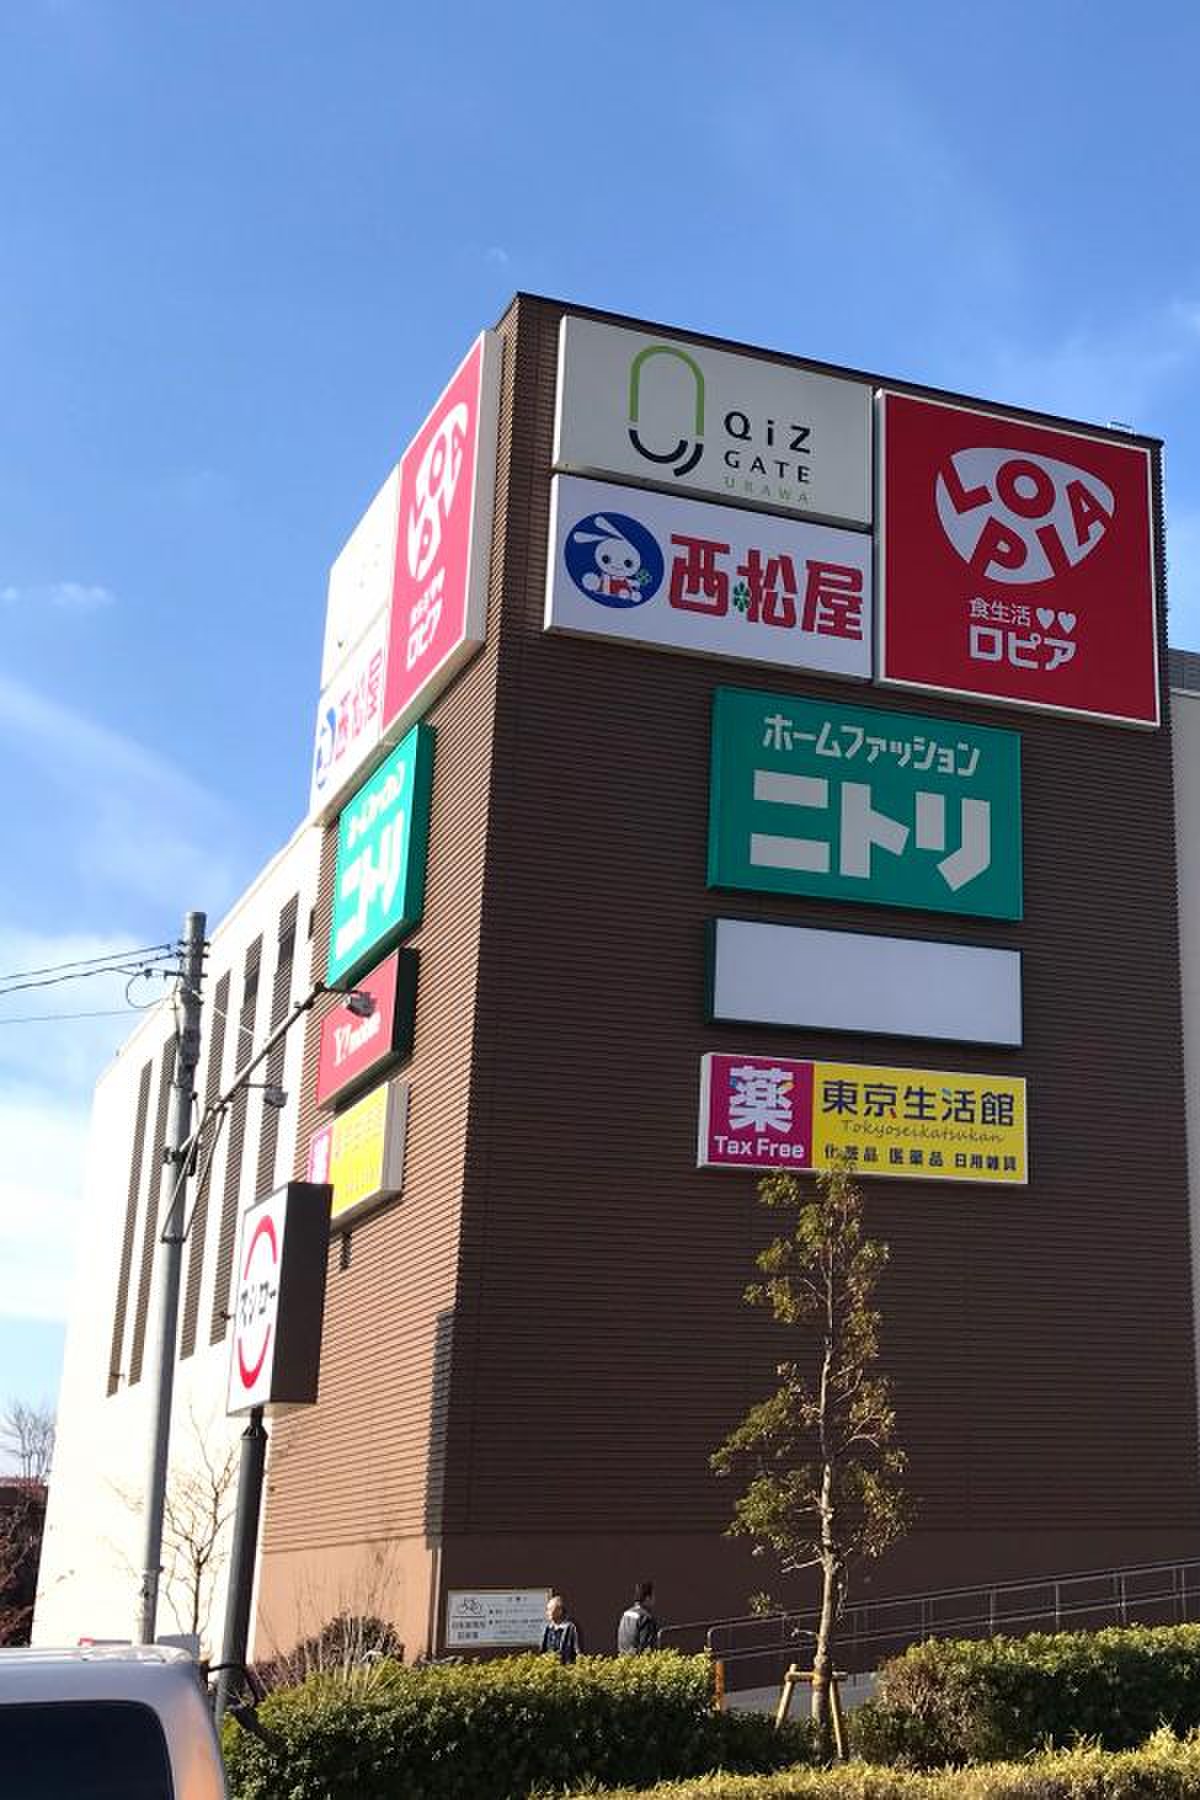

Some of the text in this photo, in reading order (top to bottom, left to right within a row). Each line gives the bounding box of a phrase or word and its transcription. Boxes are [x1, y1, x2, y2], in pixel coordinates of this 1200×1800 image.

[724, 411, 811, 454] QiZ
[724, 450, 811, 484] GATE
[938, 449, 1115, 584] LOPIA
[668, 533, 864, 642] 西松屋
[970, 597, 1031, 627] 食生活
[970, 625, 1077, 671] ロピア
[762, 713, 980, 777] ホームファッション
[750, 769, 991, 892] ニトリ
[728, 1065, 794, 1133] 薬
[822, 1079, 1015, 1127] 東京生活館
[714, 1135, 805, 1160] Tax Free
